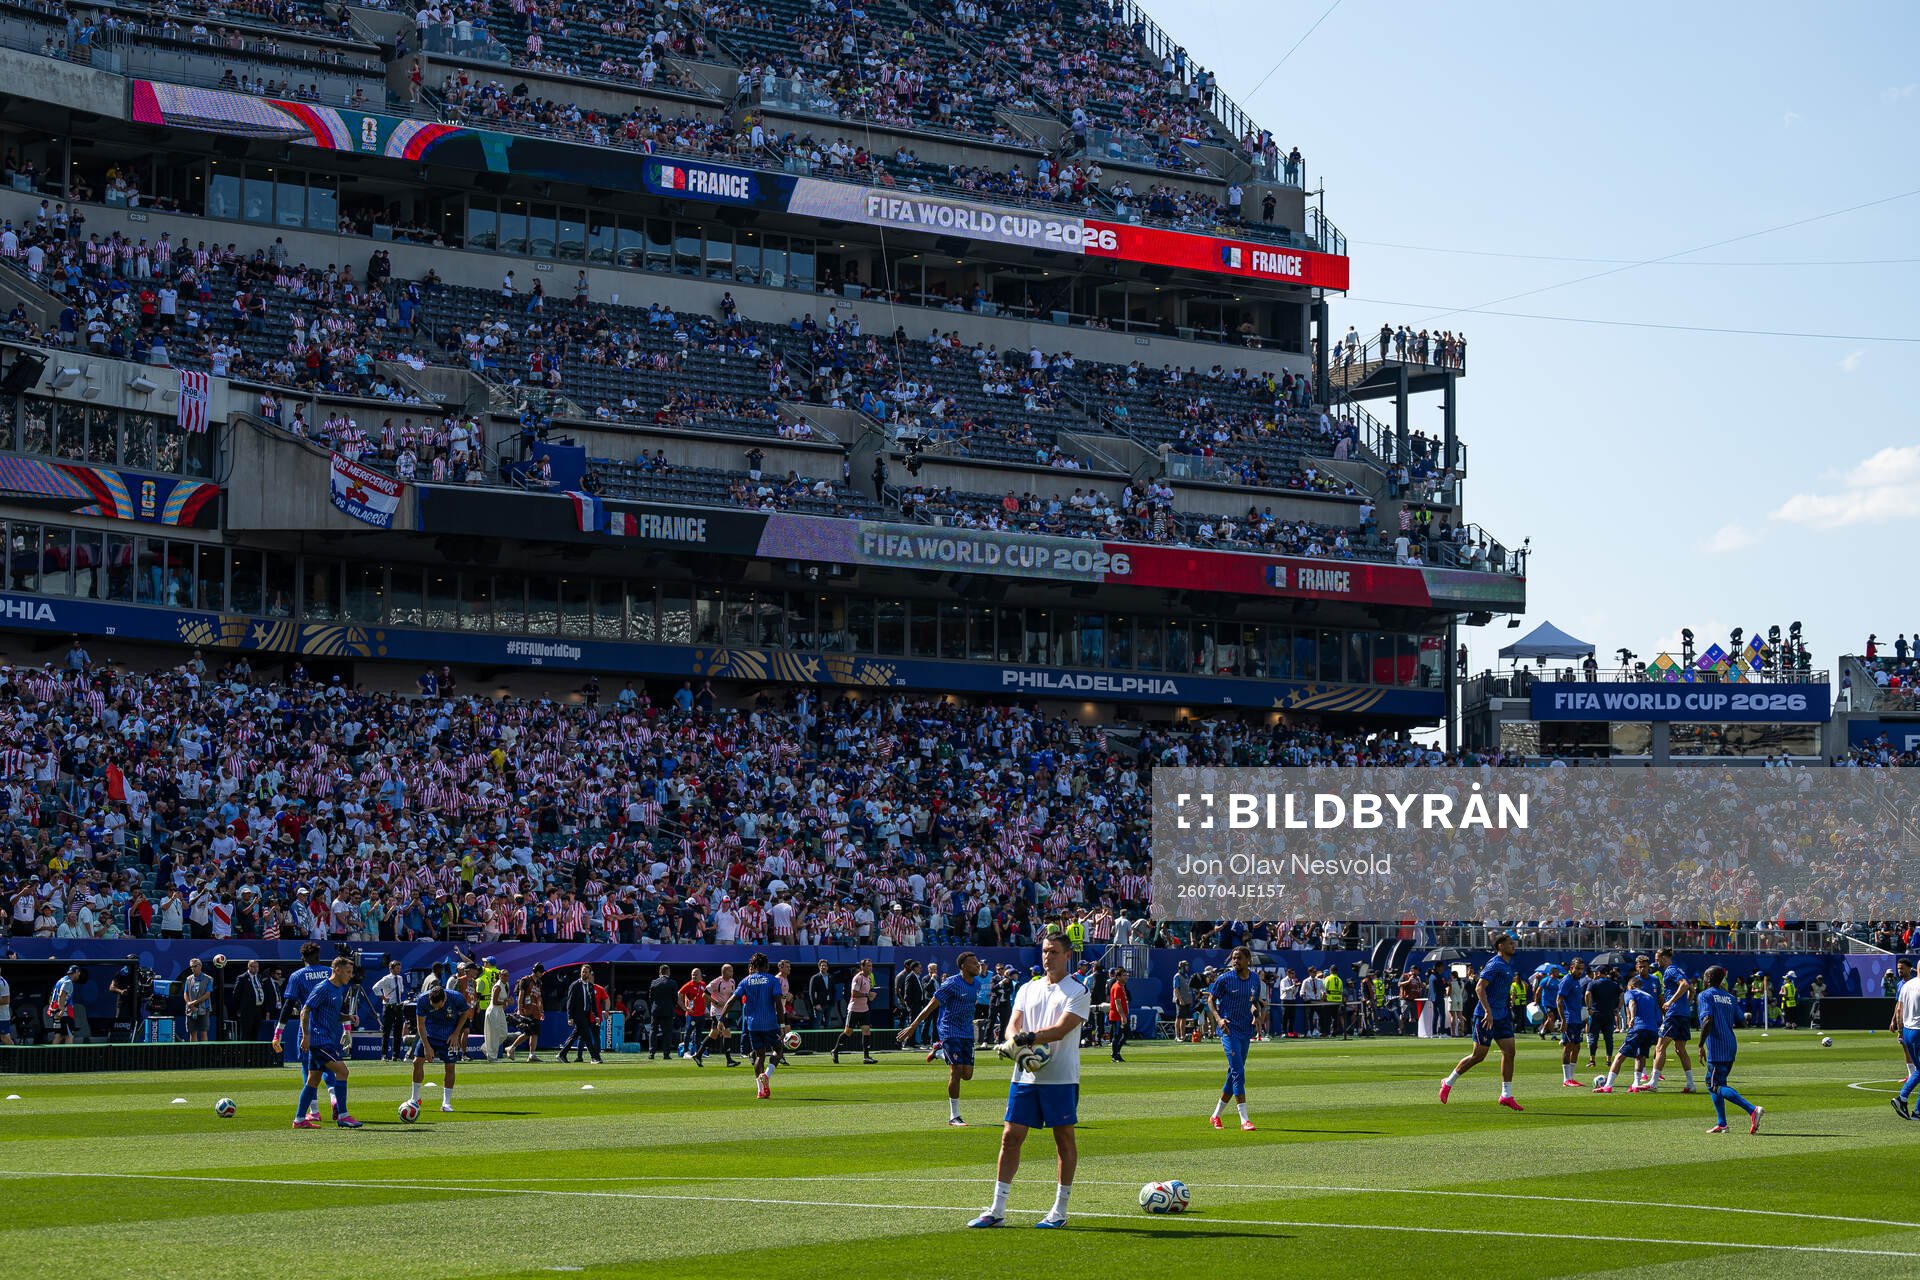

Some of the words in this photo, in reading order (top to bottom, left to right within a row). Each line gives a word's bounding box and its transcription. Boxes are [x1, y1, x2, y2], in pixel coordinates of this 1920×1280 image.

[688, 169, 749, 200] FRANCE
[867, 195, 915, 223] FIFA
[918, 202, 996, 233] WORLD
[1000, 215, 1041, 239] CUP
[1045, 222, 1118, 250] 2026
[1252, 250, 1302, 276] FRANCE
[347, 465, 398, 495] MERECEMOS
[347, 503, 389, 526] MILAGROS
[640, 513, 706, 542] FRANCE
[863, 531, 914, 558] FIFA
[917, 537, 1001, 565] WORLD
[1004, 544, 1049, 569] CUP
[1053, 548, 1131, 575] 2026
[1298, 567, 1350, 593] FRANCE
[0, 599, 56, 622] HIA
[105, 626, 116, 635] 137
[506, 641, 582, 660] #FIFAWorldCup
[1002, 670, 1179, 695] PHILADELPHIA
[1554, 693, 1601, 710] FIFA
[1603, 693, 1681, 710] WORLD
[1685, 693, 1728, 710] CUP
[1731, 694, 1807, 711] 2026
[305, 970, 329, 980] FRANCE
[1713, 994, 1732, 1005] FRANCE
